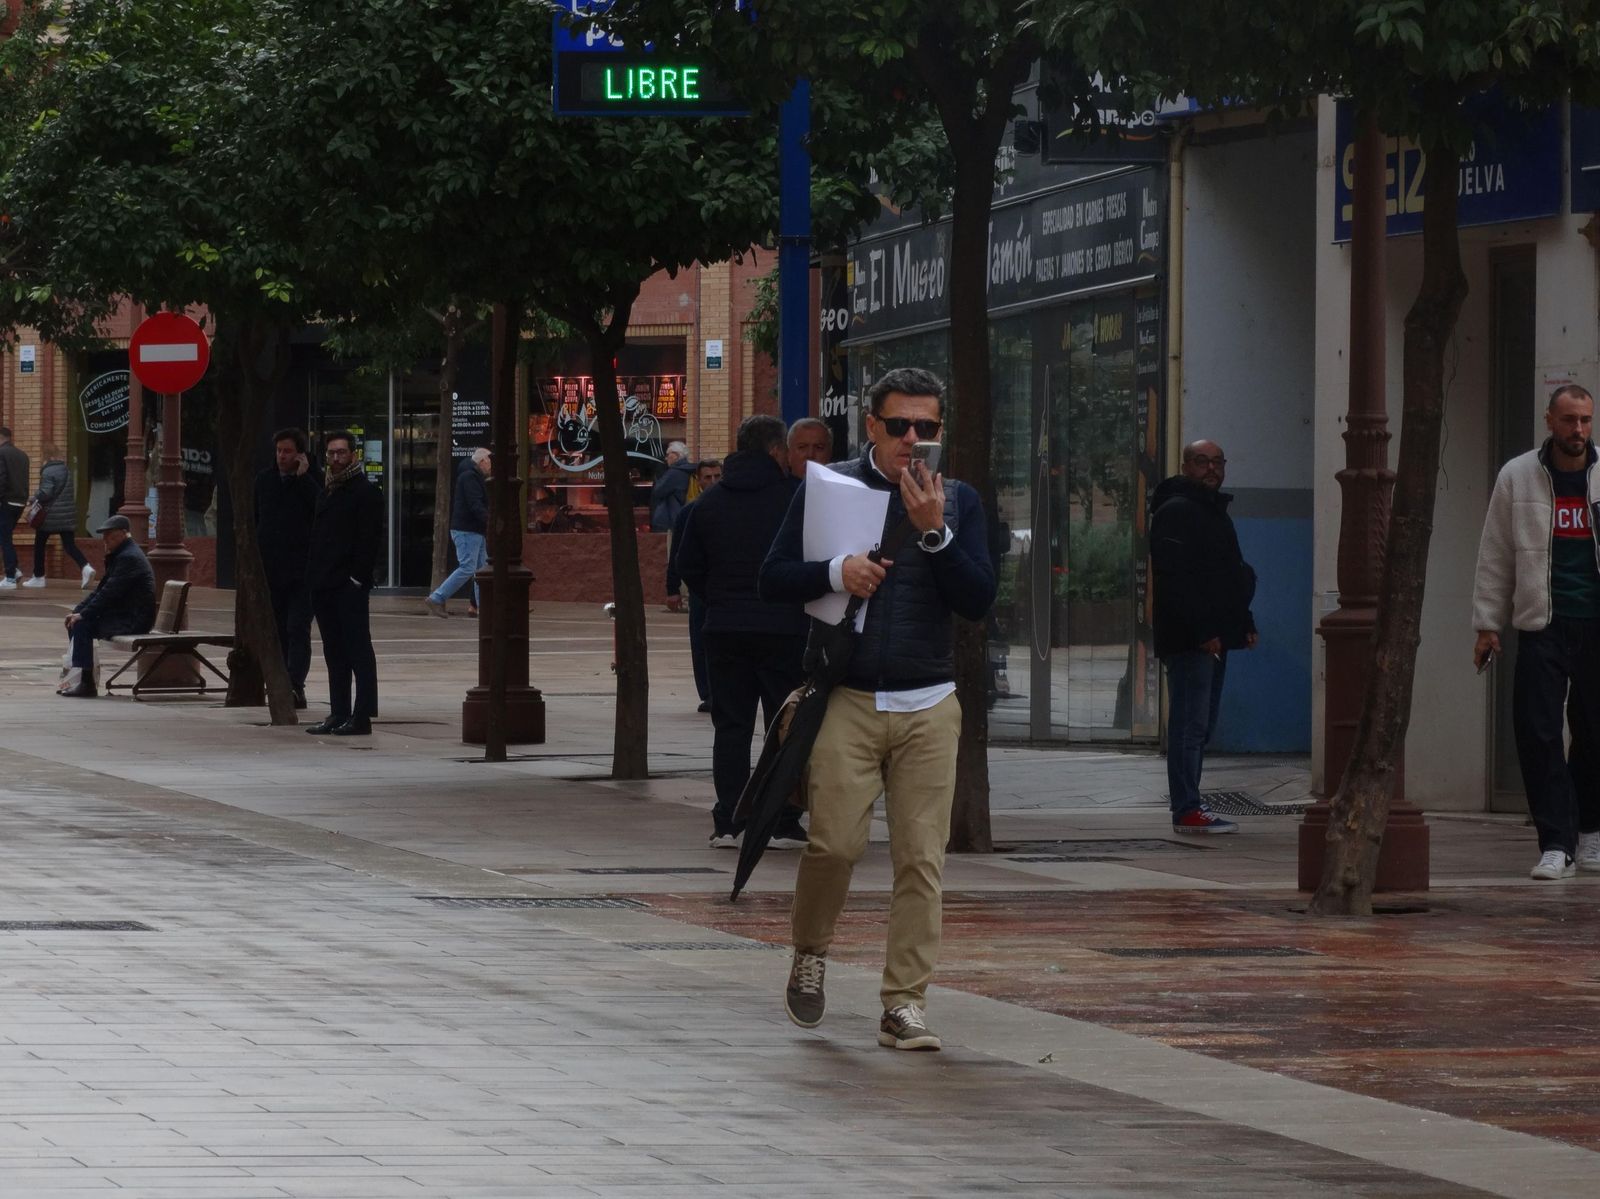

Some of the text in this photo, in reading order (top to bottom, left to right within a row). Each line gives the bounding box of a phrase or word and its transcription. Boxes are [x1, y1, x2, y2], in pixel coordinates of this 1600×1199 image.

[605, 67, 700, 99] LIBRE
[1458, 163, 1505, 196] ELVA
[1042, 191, 1127, 236] ESPECIALIDAD EN CARNES FRESCAS
[869, 239, 945, 314] El Museo
[1036, 233, 1134, 283] PALETAS Y JAMONES DE CERDO IBÉRICO
[820, 385, 848, 417] ón
